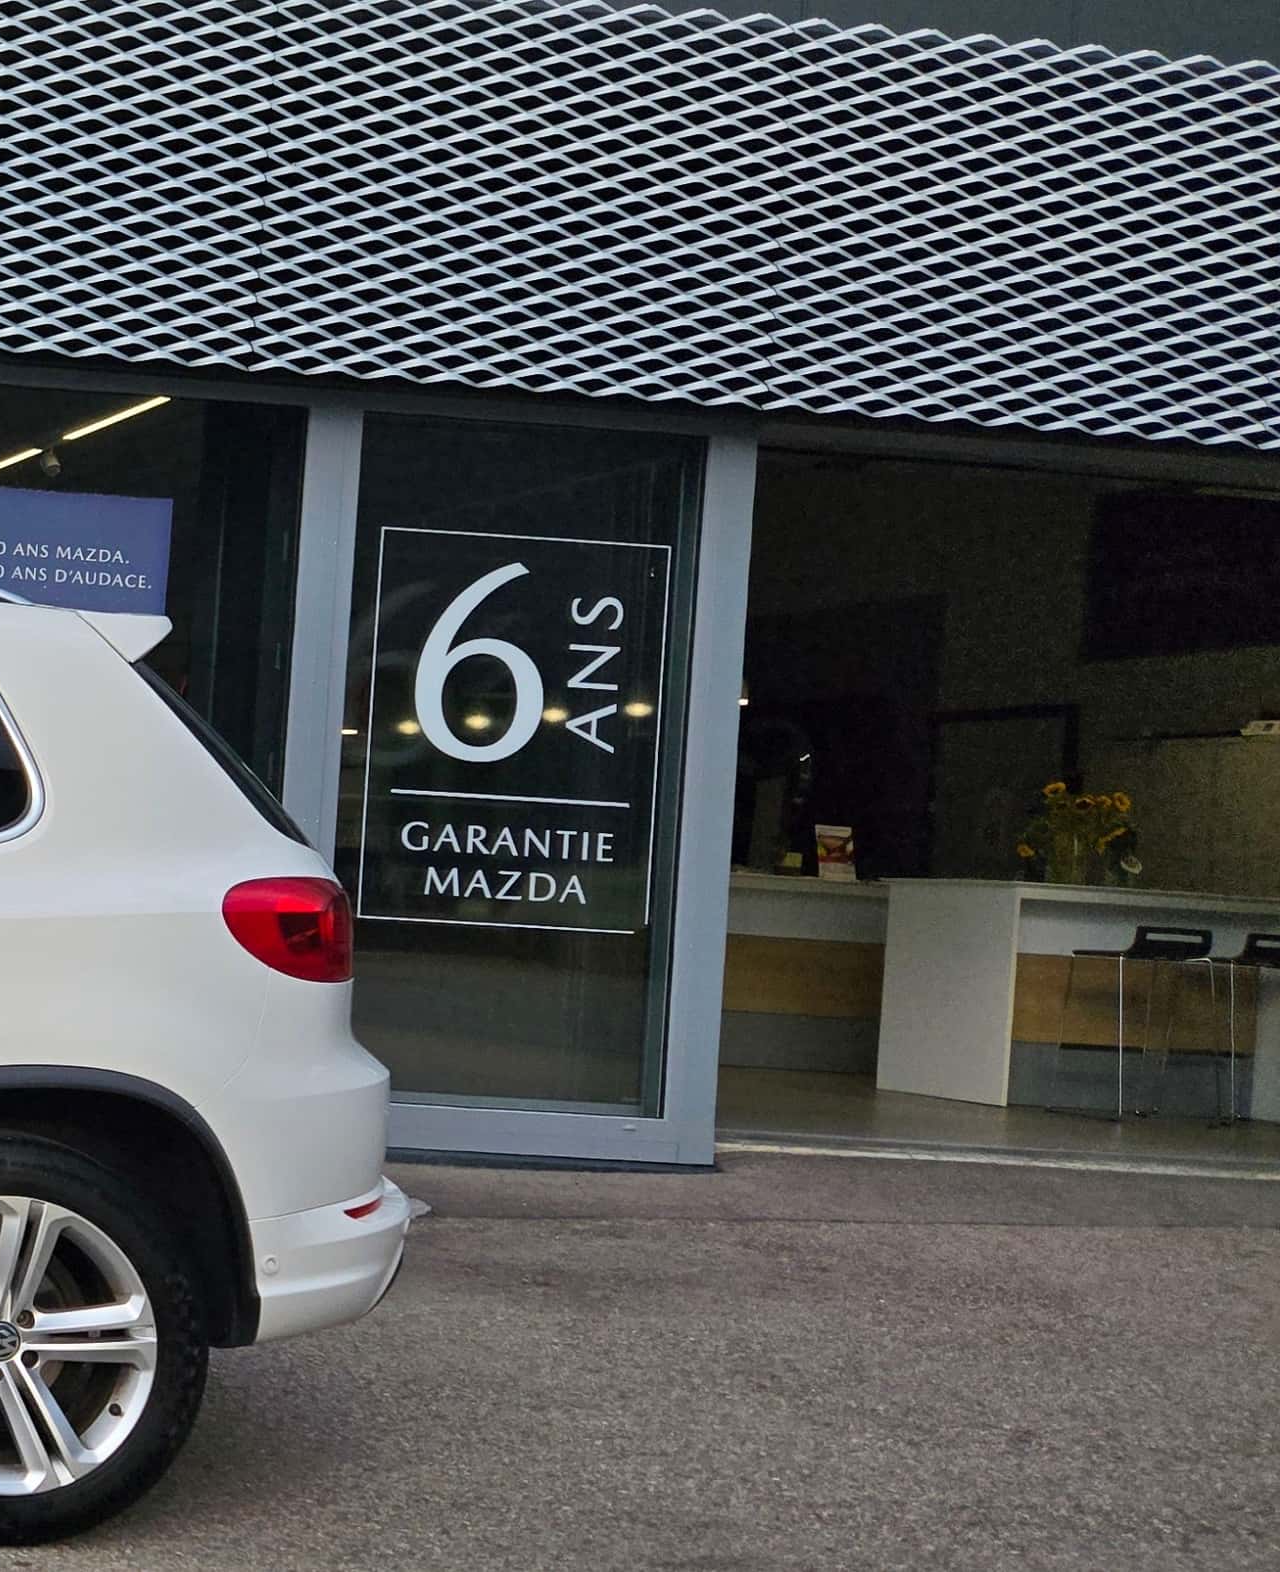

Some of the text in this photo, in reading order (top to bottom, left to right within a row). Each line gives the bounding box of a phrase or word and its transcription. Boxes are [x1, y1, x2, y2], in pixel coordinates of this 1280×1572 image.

[13, 543, 49, 559] ANS
[56, 546, 130, 565] MAZDA.
[11, 567, 48, 582] ANS
[414, 562, 544, 763] 6
[565, 596, 625, 754] ANS
[400, 821, 615, 863] GARANTIE
[423, 866, 587, 905] MAZDA
